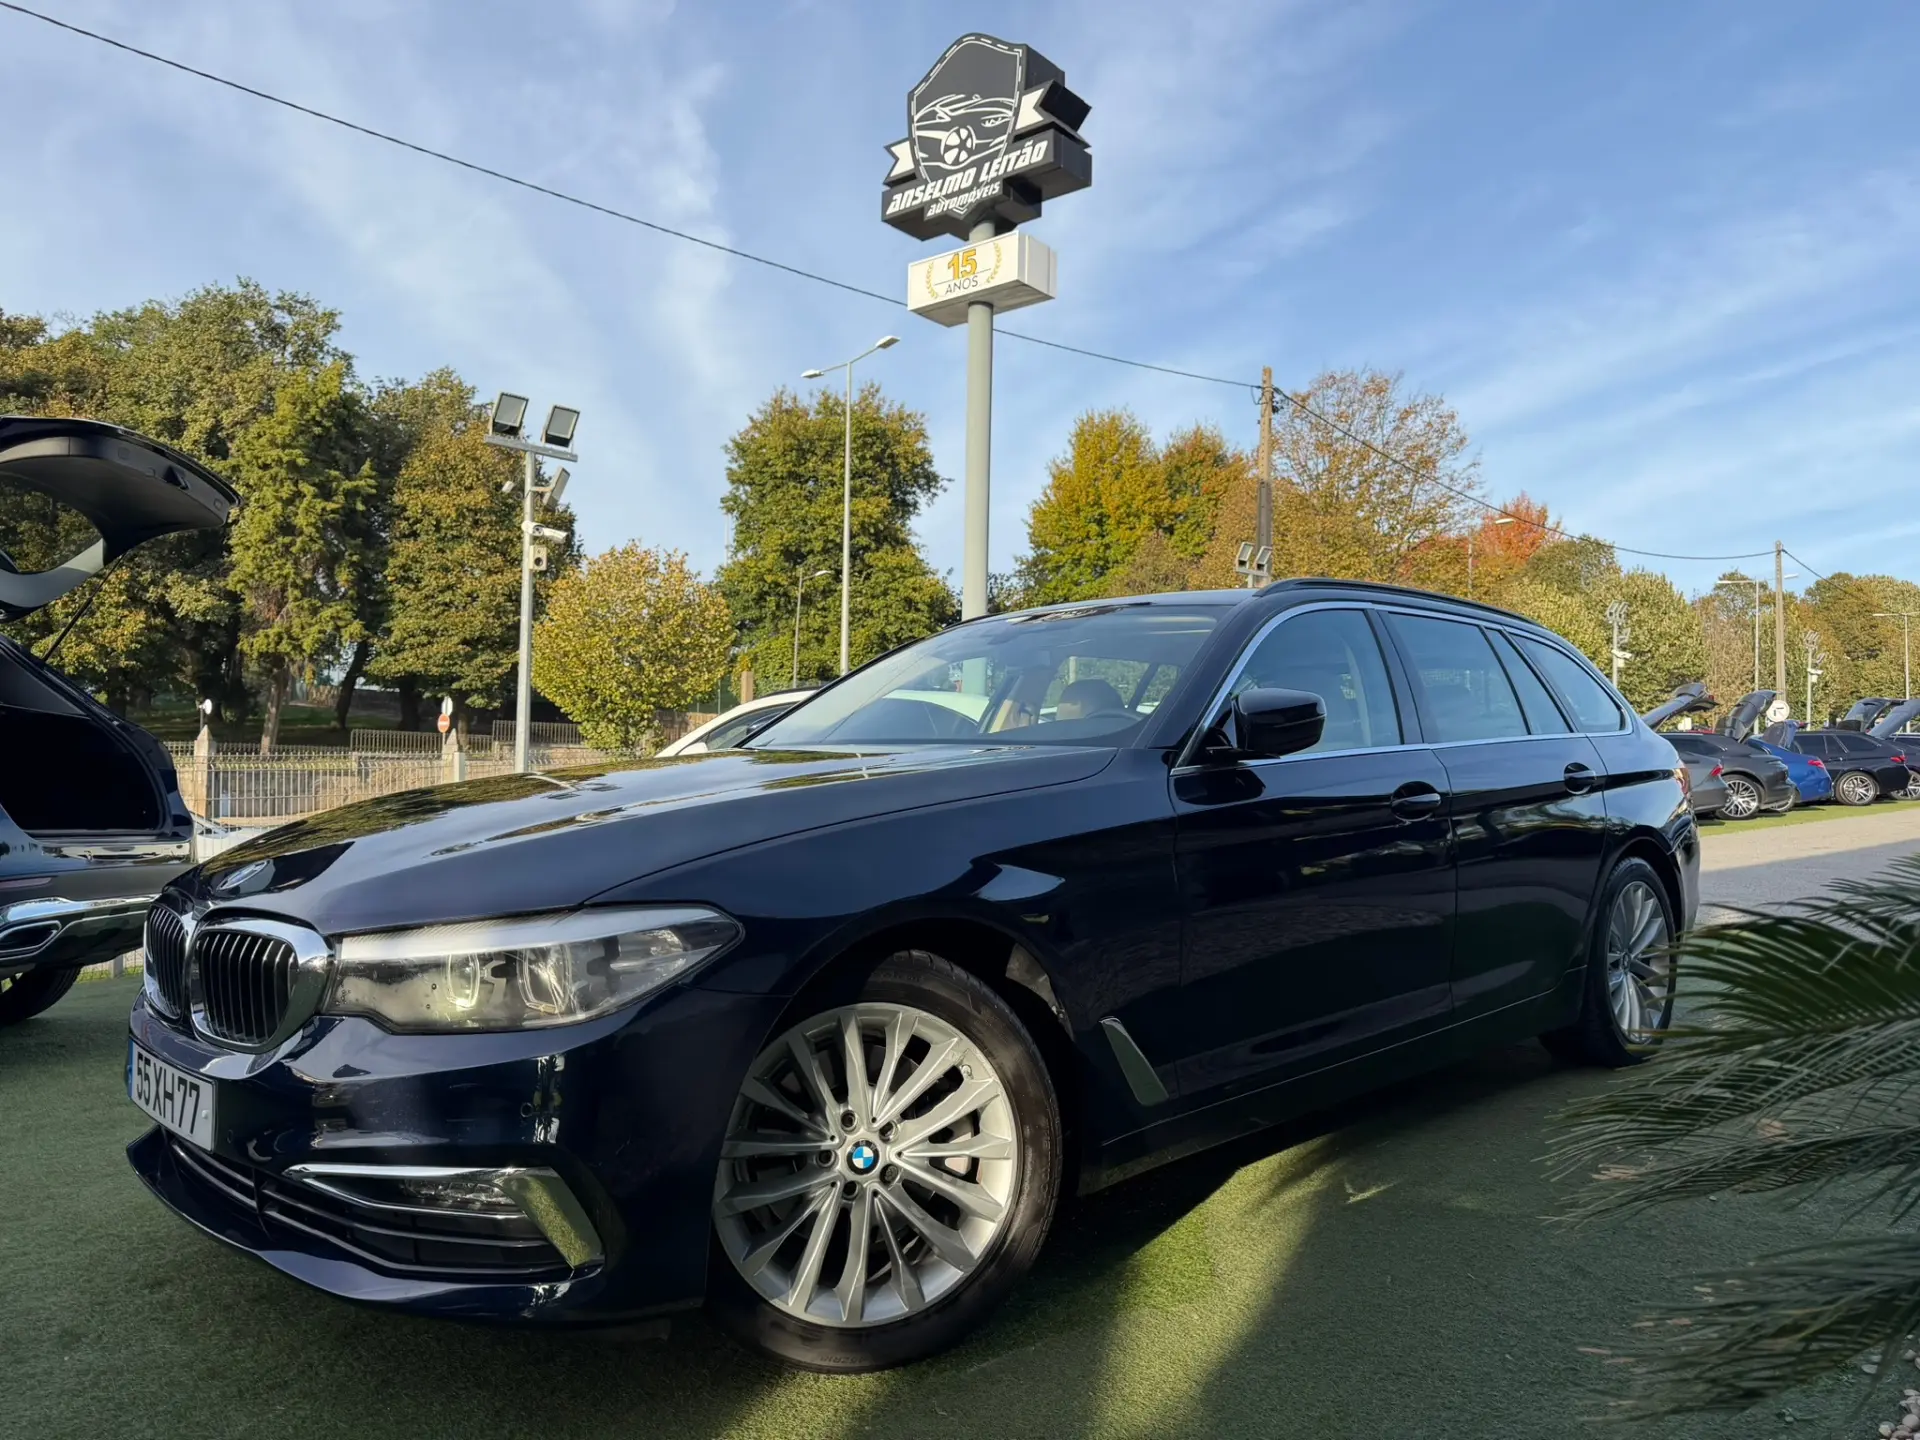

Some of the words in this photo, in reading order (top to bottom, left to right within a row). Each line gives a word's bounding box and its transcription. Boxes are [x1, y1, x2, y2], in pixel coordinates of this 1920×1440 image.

[948, 248, 978, 281] 15
[945, 275, 979, 296] ANOS
[136, 1051, 200, 1135] 55XH77
